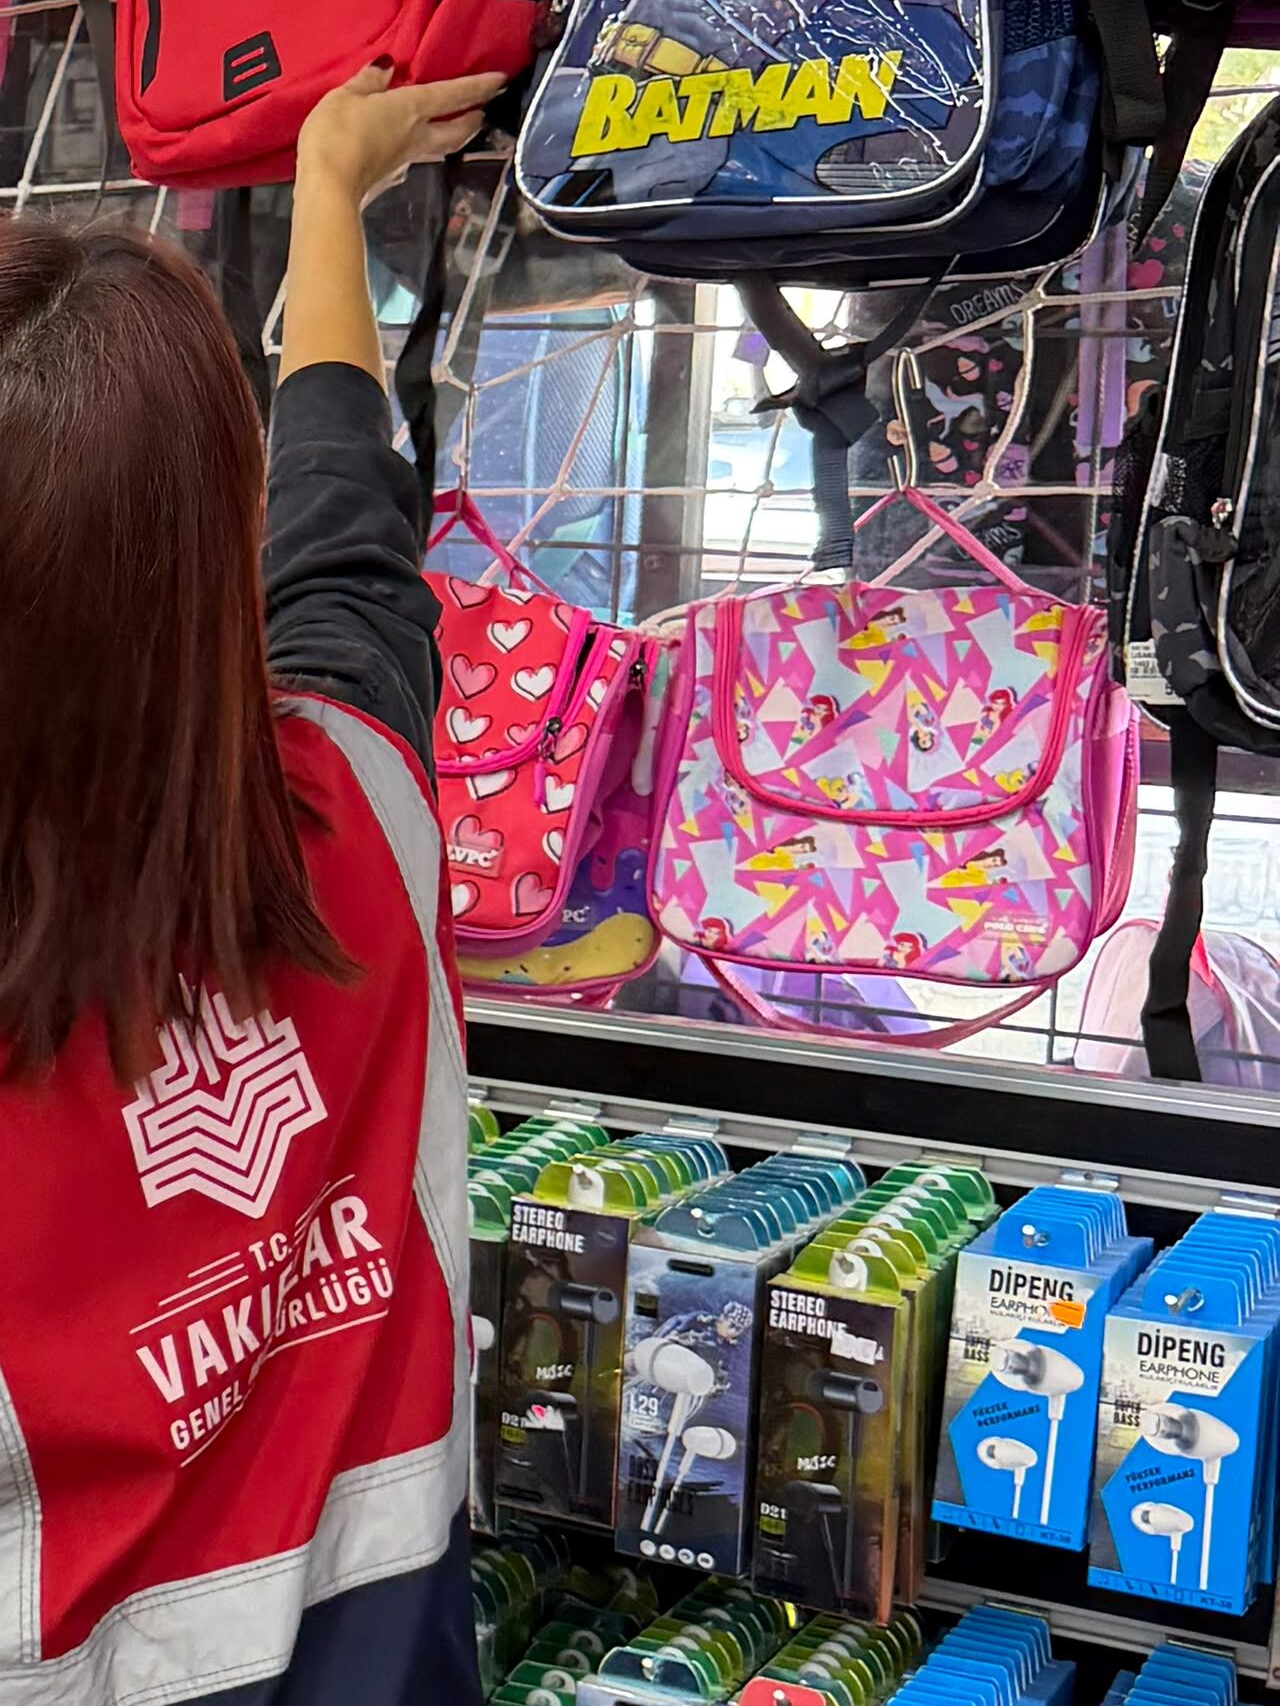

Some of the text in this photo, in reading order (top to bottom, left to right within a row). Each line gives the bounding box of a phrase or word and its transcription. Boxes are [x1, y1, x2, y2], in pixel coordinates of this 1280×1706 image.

[570, 49, 903, 159] BATMAN
[951, 281, 1027, 324] DREAMS
[512, 1204, 565, 1230] STEREO
[511, 1224, 586, 1254] EARPHONE
[248, 1232, 292, 1274] T.C.
[770, 1288, 826, 1317] STEREO
[963, 1347, 991, 1363] BASS
[536, 1364, 573, 1381] MUSIC
[1139, 1360, 1220, 1384] EARPHONE
[170, 1382, 243, 1451] GENEL
[629, 1394, 660, 1417] L29
[1113, 1412, 1141, 1427] BASS
[797, 1455, 837, 1472] MUSIC
[759, 1502, 788, 1520] D21
